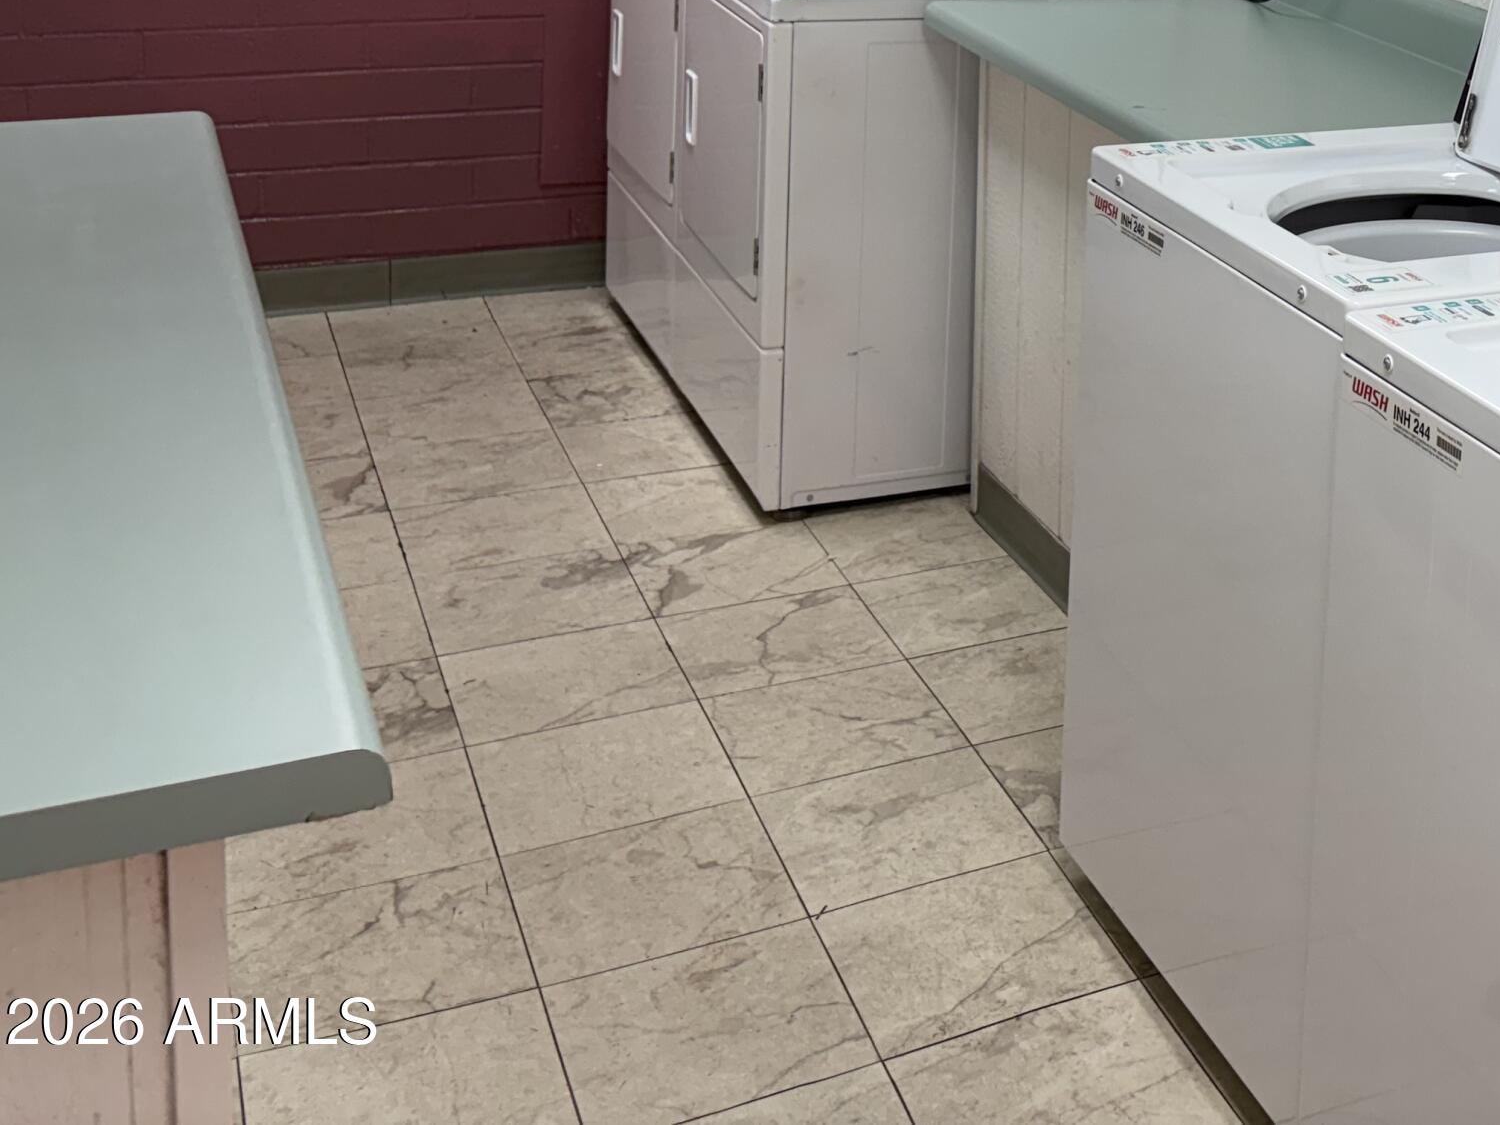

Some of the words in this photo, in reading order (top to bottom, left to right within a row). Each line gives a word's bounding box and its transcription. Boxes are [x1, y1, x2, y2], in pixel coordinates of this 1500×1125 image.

[1094, 194, 1119, 220] WASH
[1121, 212, 1132, 230] INH
[1133, 220, 1145, 237] 246
[1352, 376, 1389, 413] WASH
[1393, 404, 1411, 429] INH
[1413, 418, 1431, 441] 244
